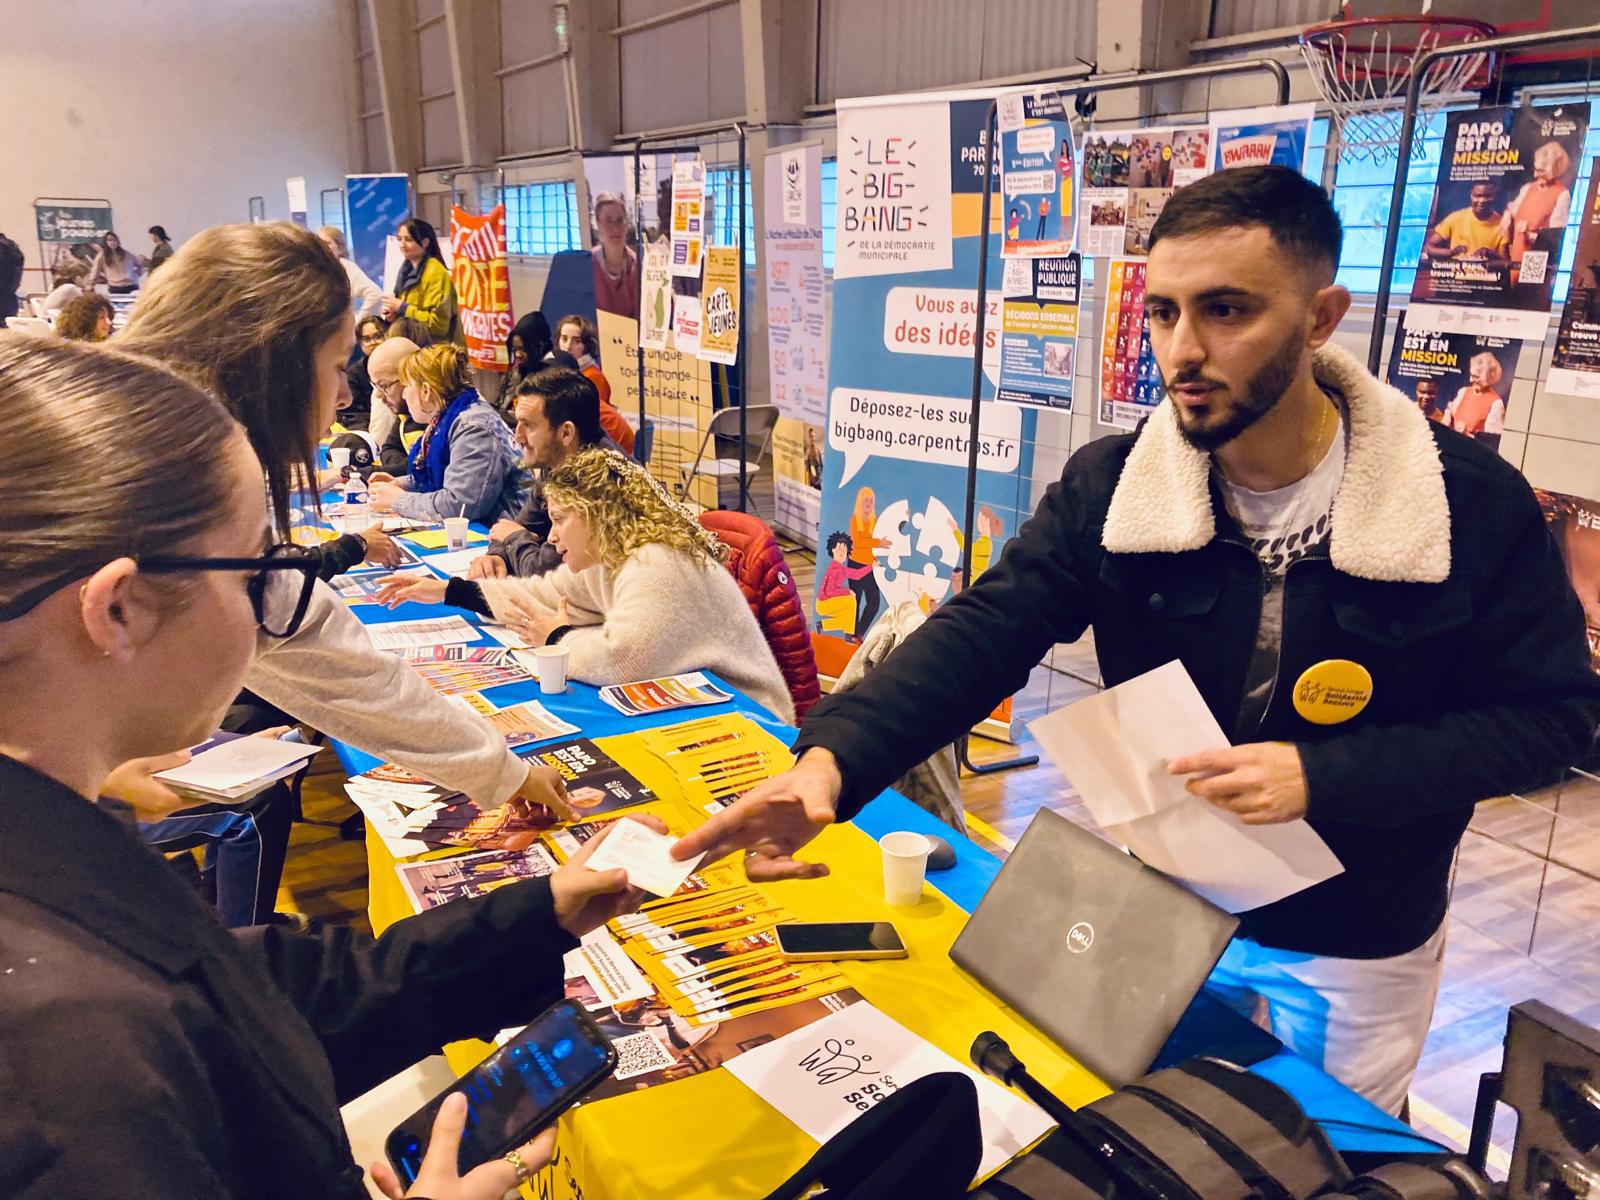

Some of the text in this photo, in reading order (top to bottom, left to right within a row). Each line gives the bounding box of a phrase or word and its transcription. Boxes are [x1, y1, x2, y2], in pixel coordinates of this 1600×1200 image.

[1458, 121, 1503, 136] PAPO
[867, 137, 902, 165] LE
[1456, 135, 1510, 151] EST EN
[961, 147, 999, 162] PARI
[1453, 149, 1519, 165] MISSION
[863, 172, 916, 199] BIG-
[845, 206, 912, 233] BANG
[860, 239, 935, 250] DE LA DÉMOCRATIE
[859, 252, 908, 260] MUNICIPALE
[1038, 271, 1077, 287] PUBLIQUE
[706, 292, 729, 314] CARTE
[915, 294, 955, 314] Vous
[708, 310, 736, 335] JEUNES
[895, 320, 930, 343] des
[1403, 337, 1449, 352] EST EN
[648, 350, 682, 361] unique
[1401, 349, 1457, 366] MISSION
[620, 366, 641, 378] tou
[656, 370, 690, 382] monde
[627, 386, 687, 400] pet le faire
[850, 397, 944, 424] Déposez-les
[553, 748, 588, 773] EST EN
[567, 744, 597, 766] PAPO
[539, 752, 579, 780] MISSION
[843, 1092, 870, 1111] se
[860, 1083, 886, 1102] so
